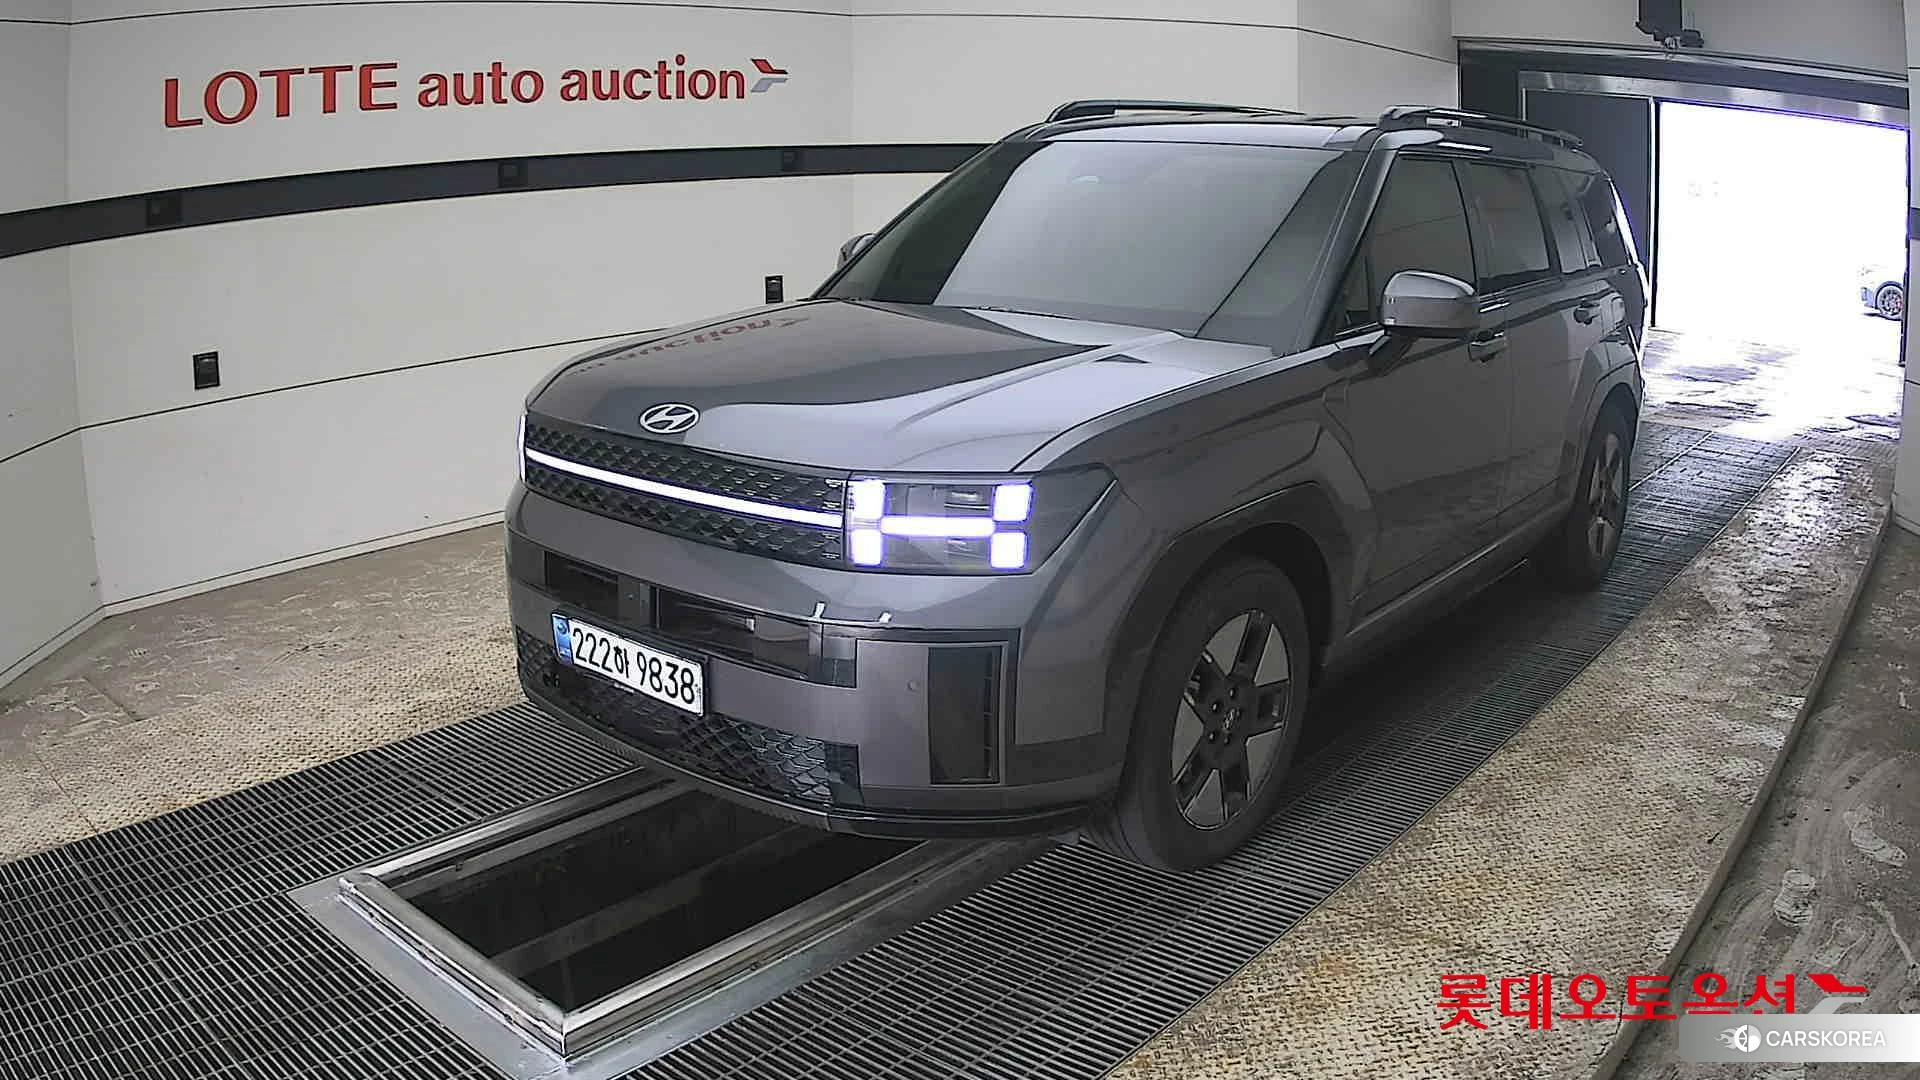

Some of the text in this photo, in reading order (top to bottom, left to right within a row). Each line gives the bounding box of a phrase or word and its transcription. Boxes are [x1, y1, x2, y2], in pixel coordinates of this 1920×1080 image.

[163, 54, 746, 128] LOTTE auto auction
[636, 651, 695, 705] 9838
